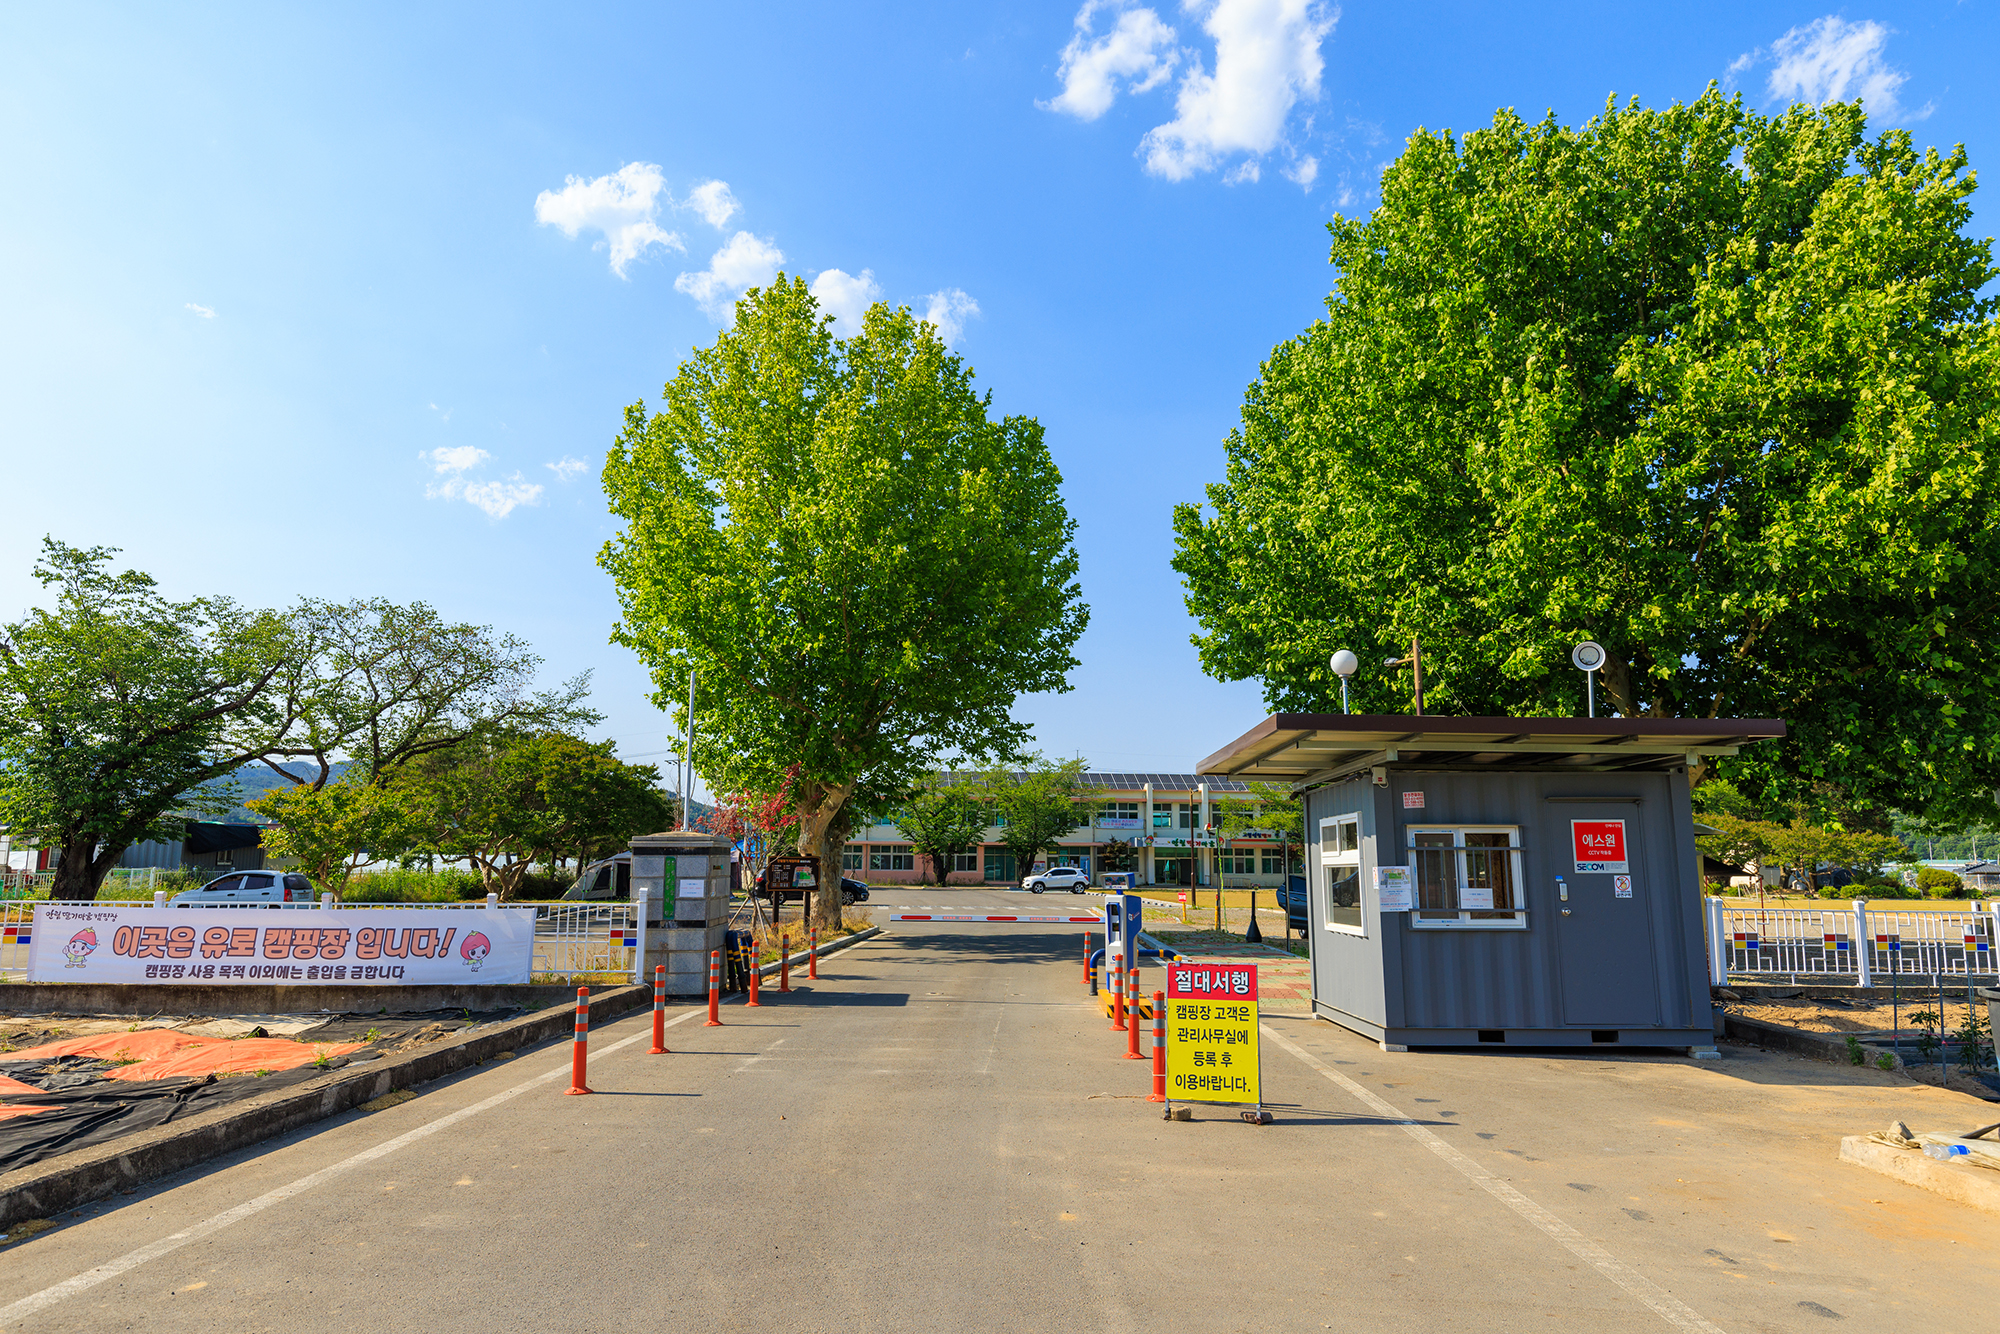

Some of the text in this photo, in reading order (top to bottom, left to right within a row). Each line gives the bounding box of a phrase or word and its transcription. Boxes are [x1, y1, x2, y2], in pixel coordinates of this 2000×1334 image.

[1582, 834, 1616, 847] 에스원
[1576, 863, 1605, 871] SECOM
[112, 925, 457, 960] 이곳은 유로 캠핑장 입니다!
[145, 964, 405, 980] 캠핑장 사용 목적 이외에는 출입을 금합니다
[1175, 970, 1250, 995] 절대서행
[1176, 1005, 1250, 1022] 캠핑장 고객은
[1177, 1027, 1248, 1045] 관리사무실에
[1193, 1051, 1233, 1068] 등록 후
[1175, 1073, 1251, 1092] 이용바랍니다.
